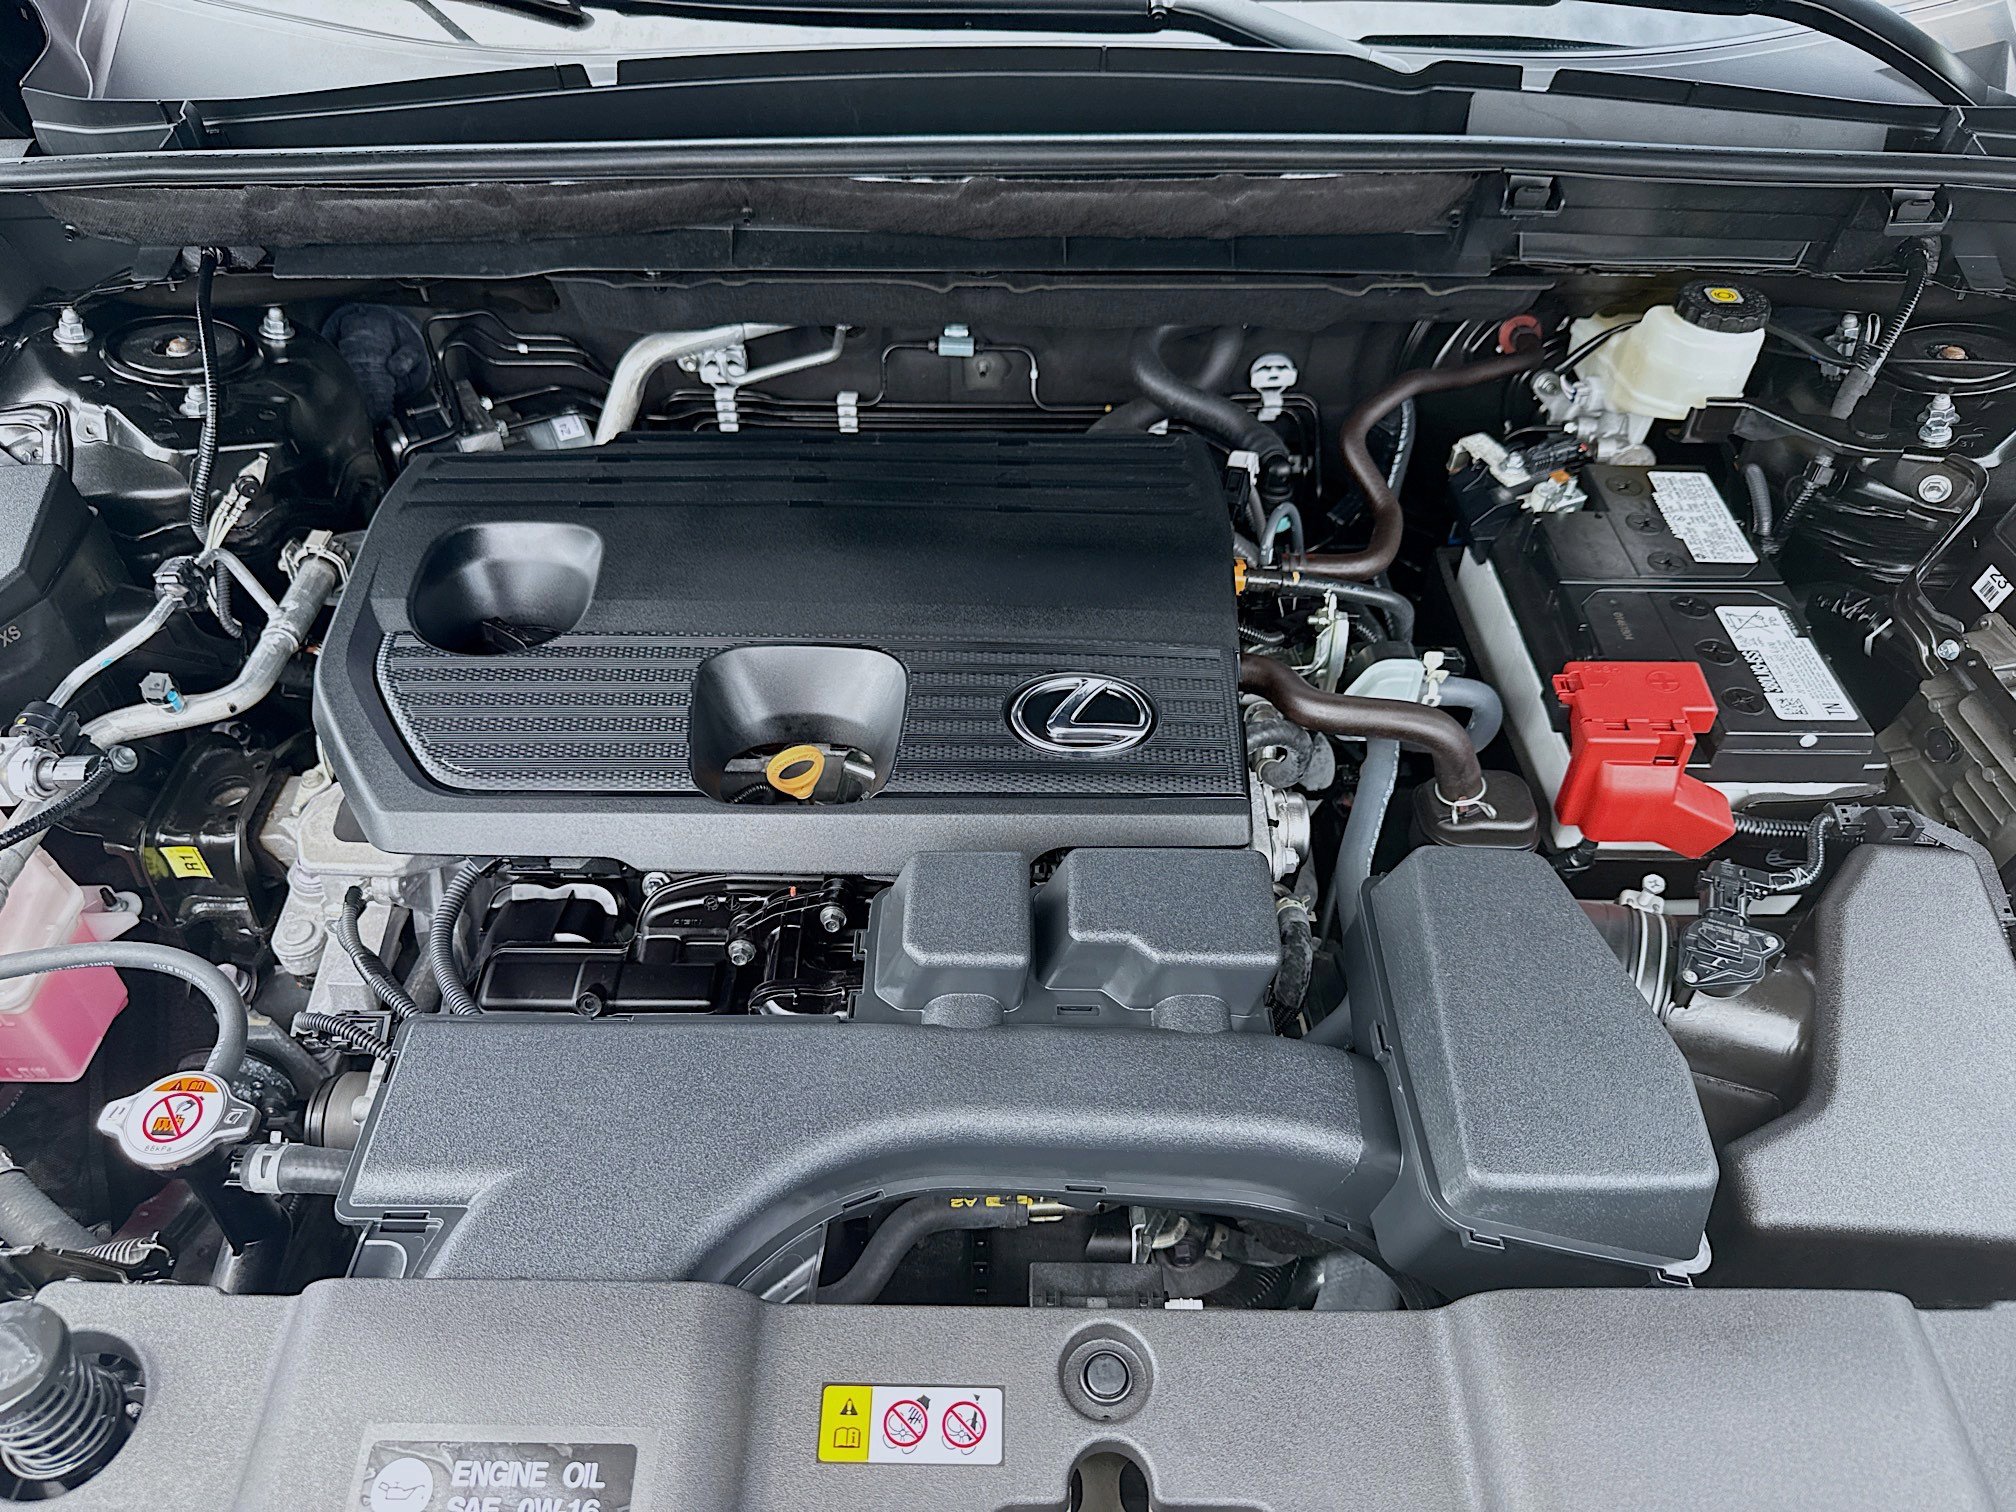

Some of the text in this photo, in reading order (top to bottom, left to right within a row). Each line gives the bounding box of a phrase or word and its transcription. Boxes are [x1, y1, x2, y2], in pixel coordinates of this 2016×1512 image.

[179, 855, 201, 871] R1
[450, 1459, 606, 1489] ENGINE OIL
